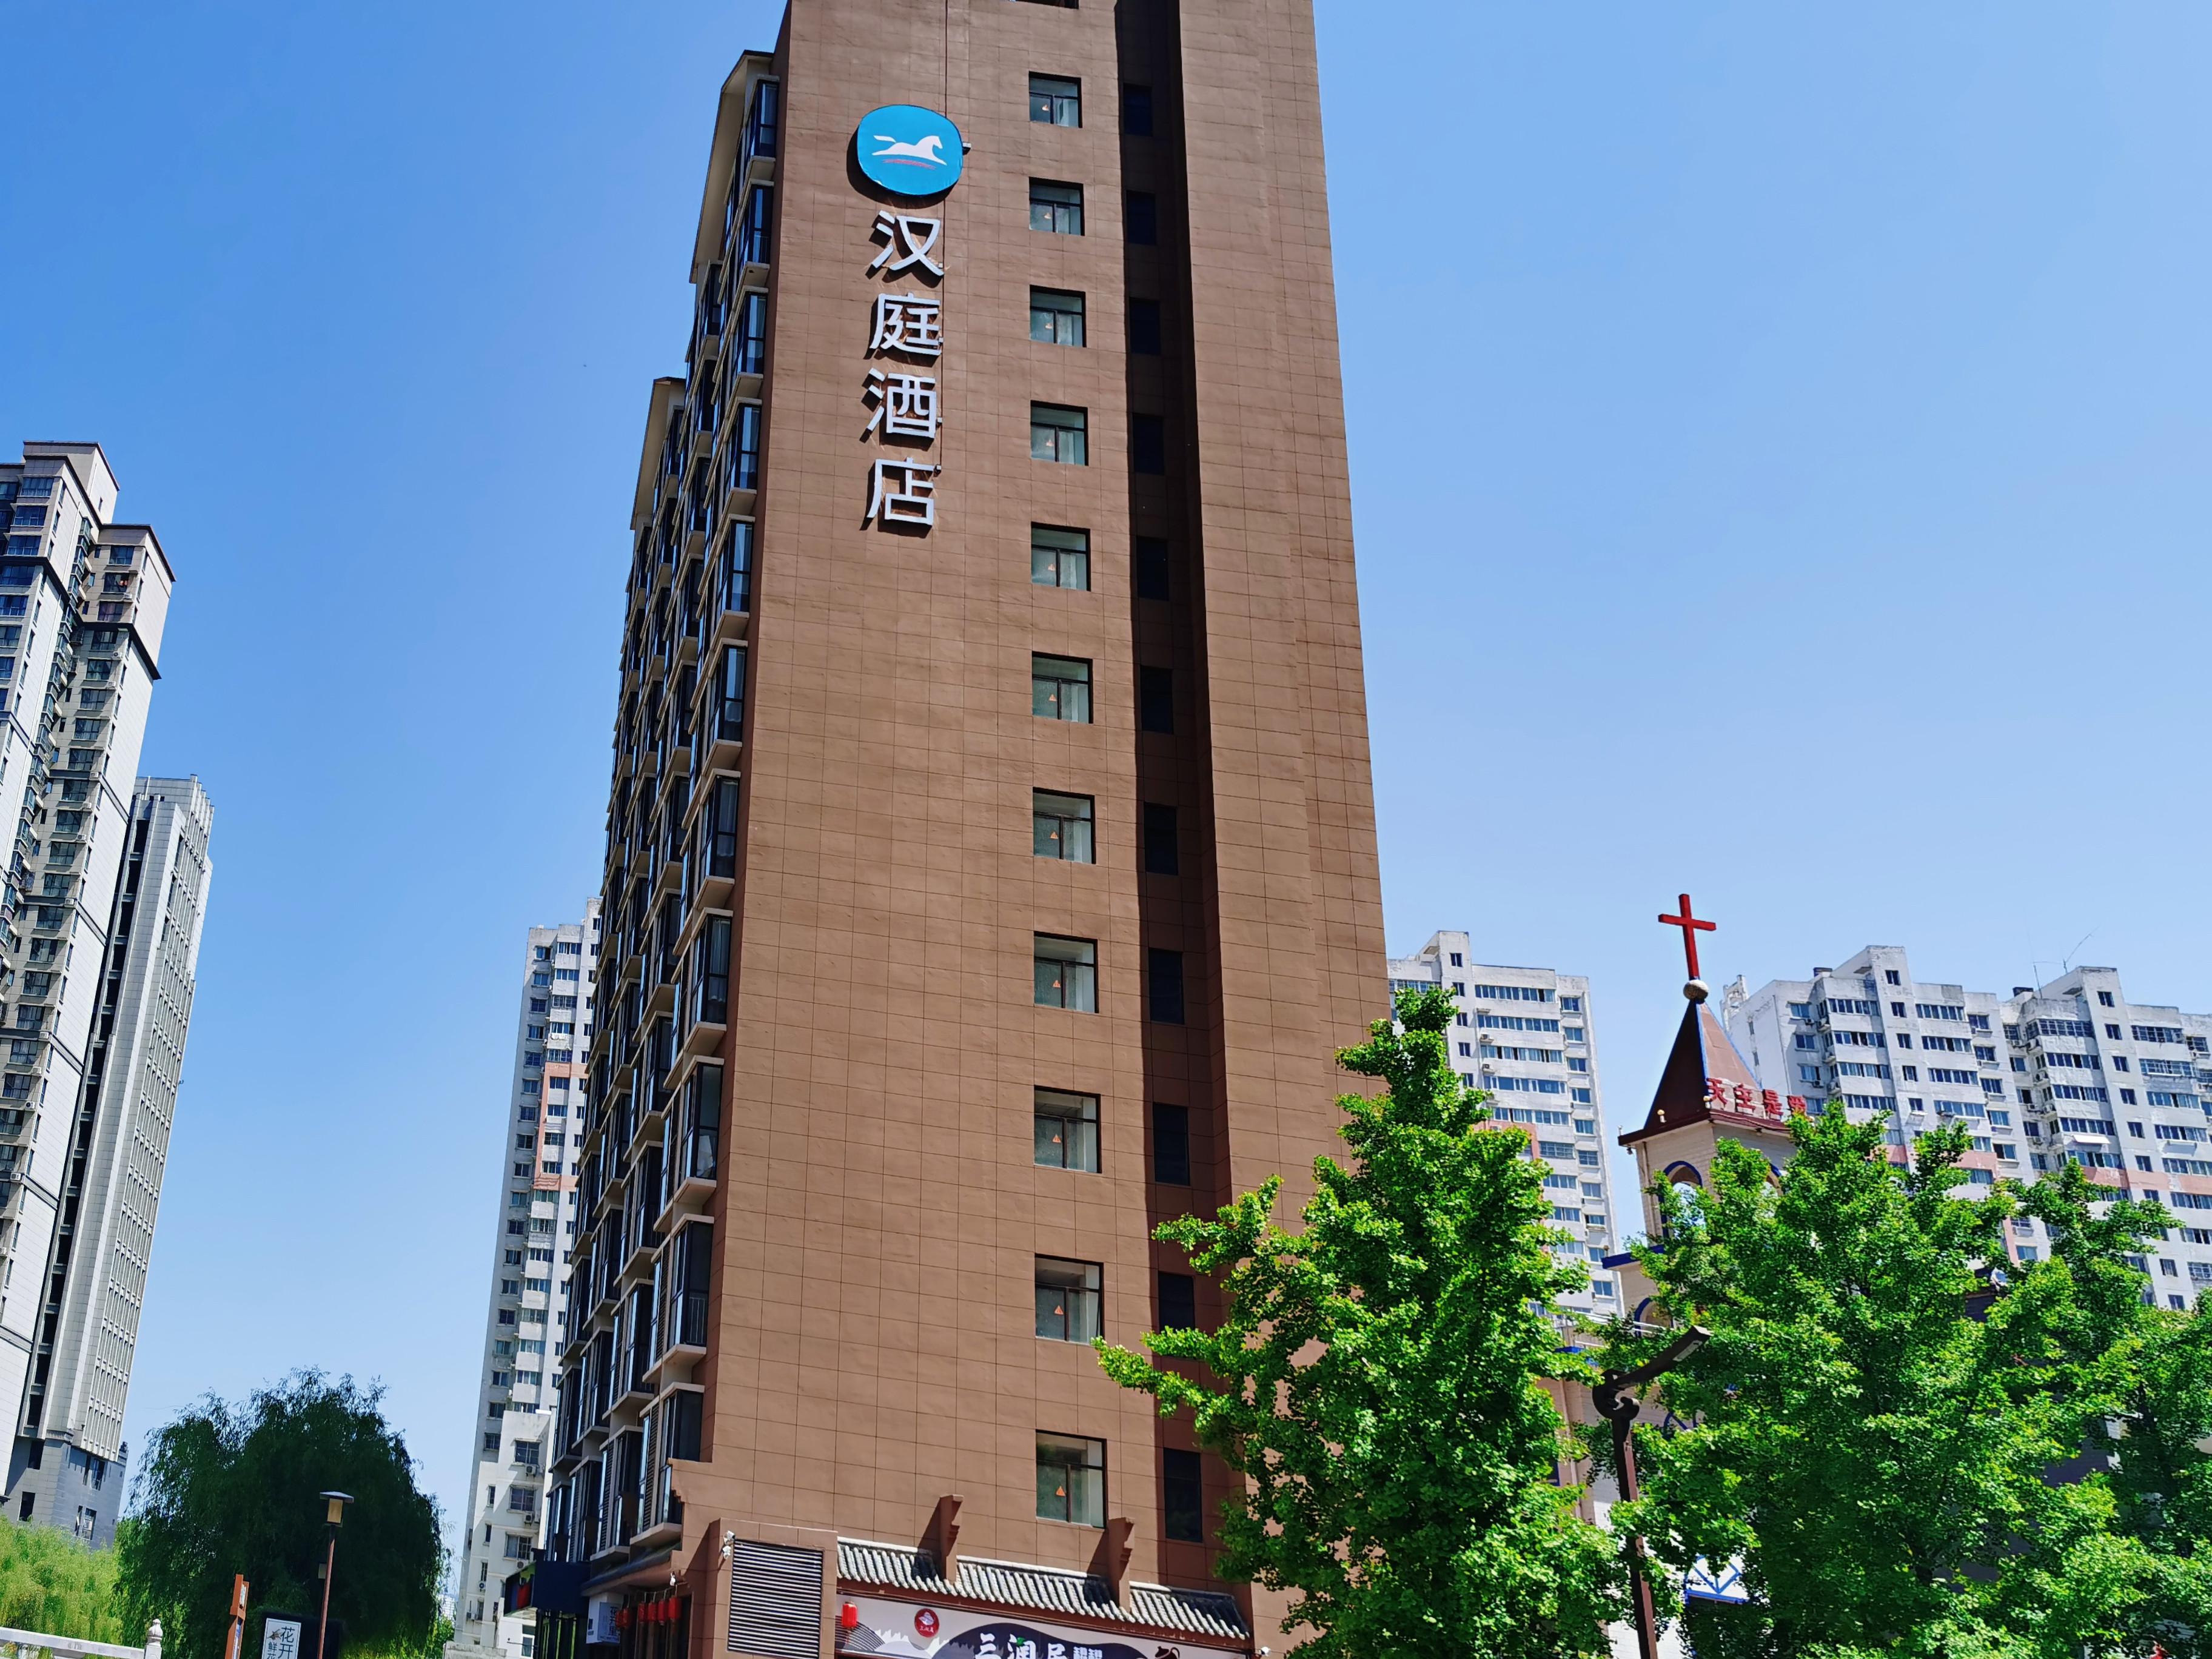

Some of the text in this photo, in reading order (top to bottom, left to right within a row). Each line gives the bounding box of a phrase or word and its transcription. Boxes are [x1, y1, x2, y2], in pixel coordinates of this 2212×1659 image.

[866, 210, 944, 526] 汉庭酒店
[278, 1626, 295, 1659] 花开
